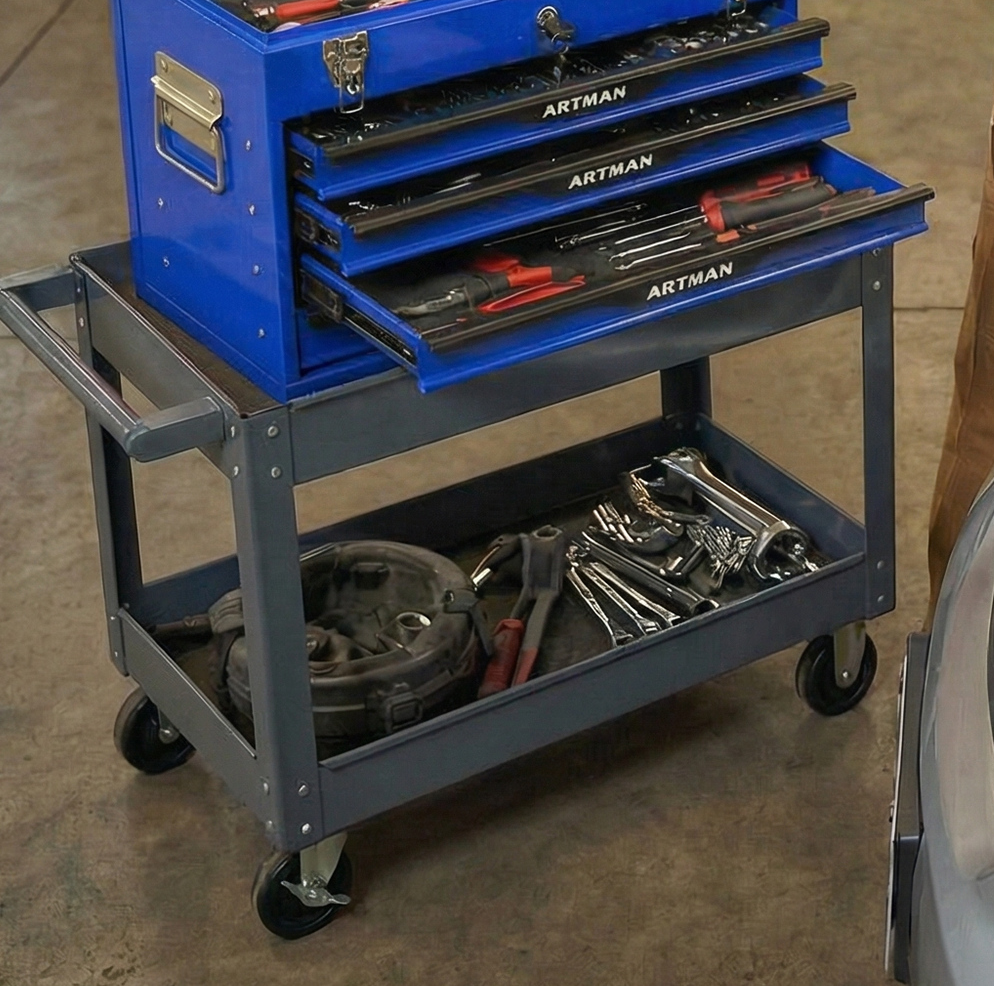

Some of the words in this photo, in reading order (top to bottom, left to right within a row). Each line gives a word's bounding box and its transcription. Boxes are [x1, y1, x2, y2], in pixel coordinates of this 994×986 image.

[542, 85, 626, 118] ARTMAN
[567, 153, 653, 190] ARTMAN
[646, 261, 733, 301] ARTMAN
